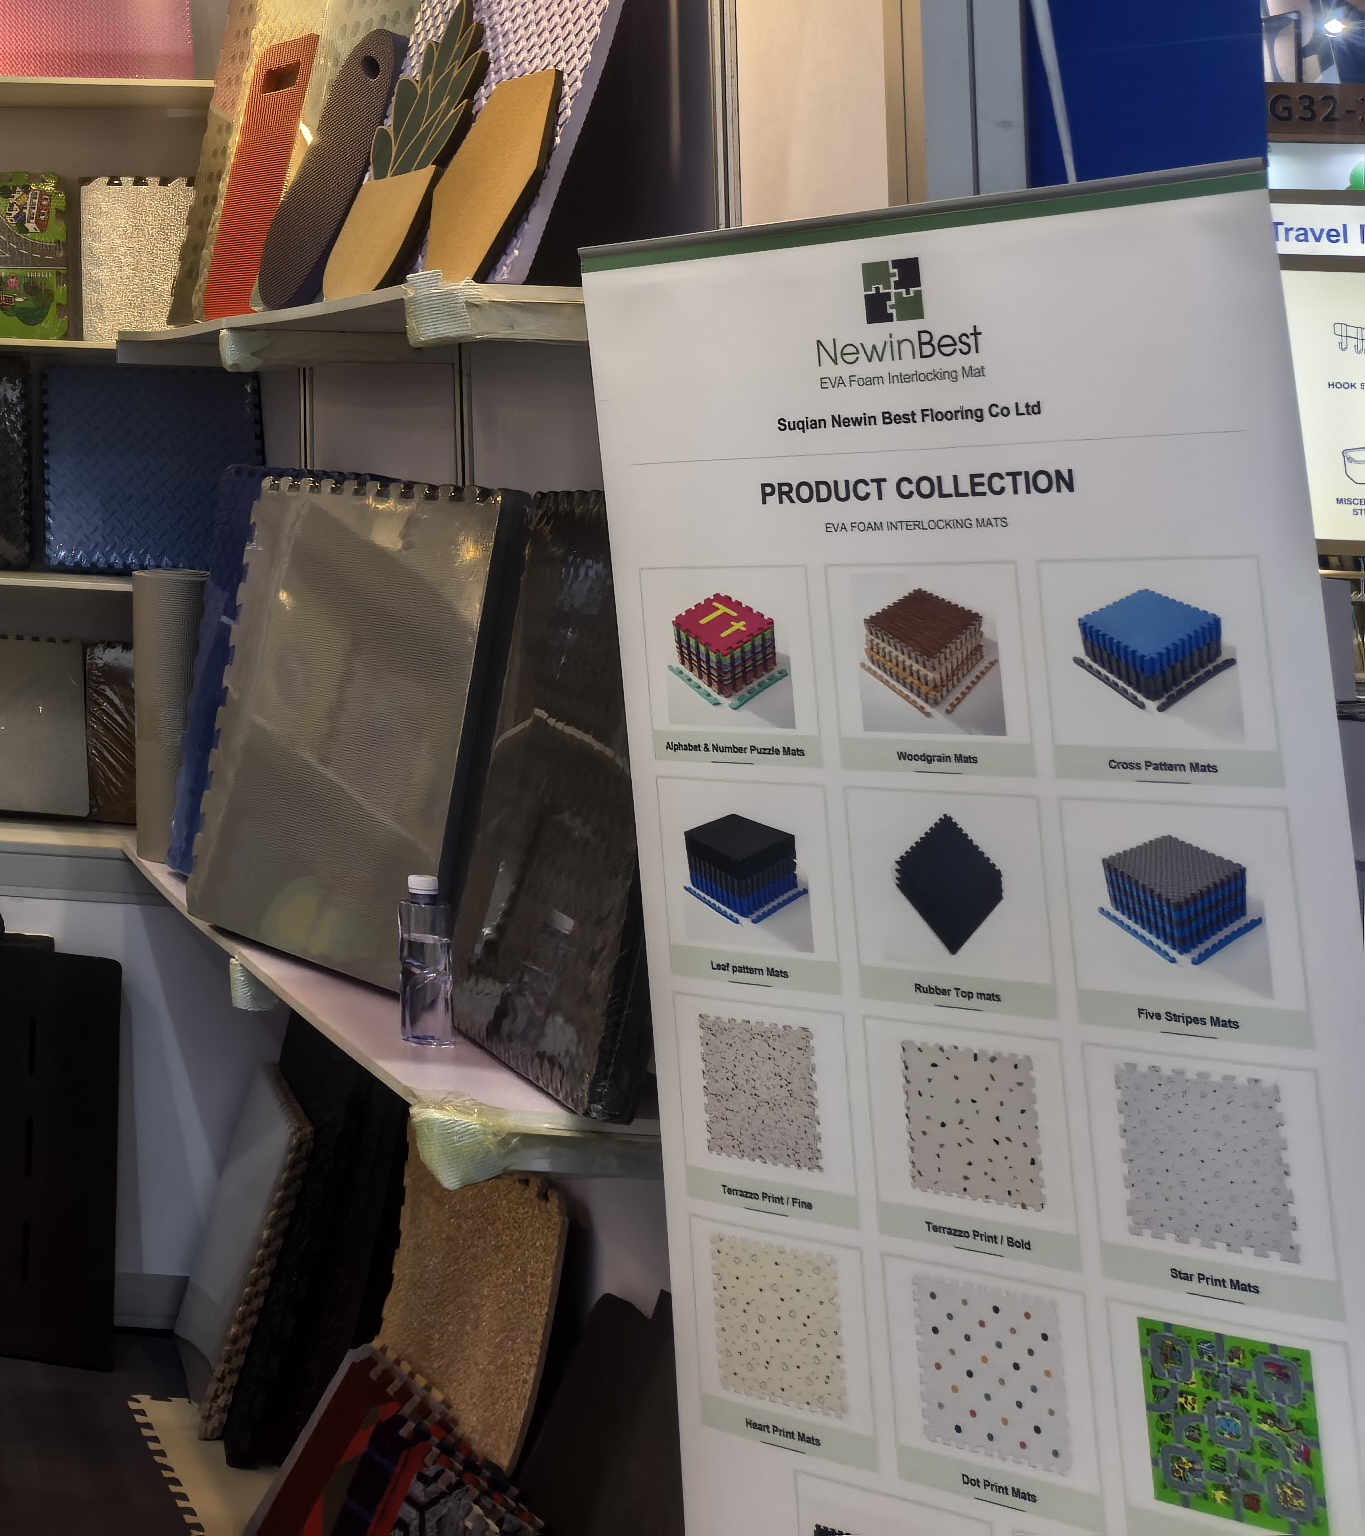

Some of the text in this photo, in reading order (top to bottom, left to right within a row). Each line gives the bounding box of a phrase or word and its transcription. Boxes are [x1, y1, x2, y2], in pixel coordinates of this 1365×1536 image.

[1269, 94, 1365, 122] G32-
[1272, 222, 1349, 244] Travel
[815, 325, 983, 368] NewinBest
[819, 364, 986, 390] EVA Foam Interlocking Mat
[1327, 381, 1357, 390] HOOK
[776, 400, 1042, 434] Suqian Newin Best Flooring Co Ltd
[760, 468, 1076, 506] PRODUCT COLLECTION
[824, 516, 1009, 534] EVA FOAM INTERLOCKING MATS
[666, 741, 806, 757] Alphabet & Number Puzzle Mats
[897, 751, 979, 765] Woodgrain Mats
[1108, 759, 1219, 773] Cross Pattern Mats
[711, 960, 789, 979] Leaf pattern Mats
[914, 983, 1002, 1002] Rubber Top mats
[1137, 1007, 1240, 1030] Five Stripes Mats
[721, 1184, 760, 1200] Terrazzo
[761, 1192, 785, 1206] Print
[791, 1198, 813, 1210] Fine
[924, 1221, 971, 1239] Terrazzo
[972, 1230, 999, 1245] Print
[1006, 1237, 1032, 1251] Bold
[1170, 1268, 1260, 1294] Star Print Mats
[745, 1417, 821, 1447] Heart Print Mats
[961, 1472, 1038, 1503] Dot Print Mats
